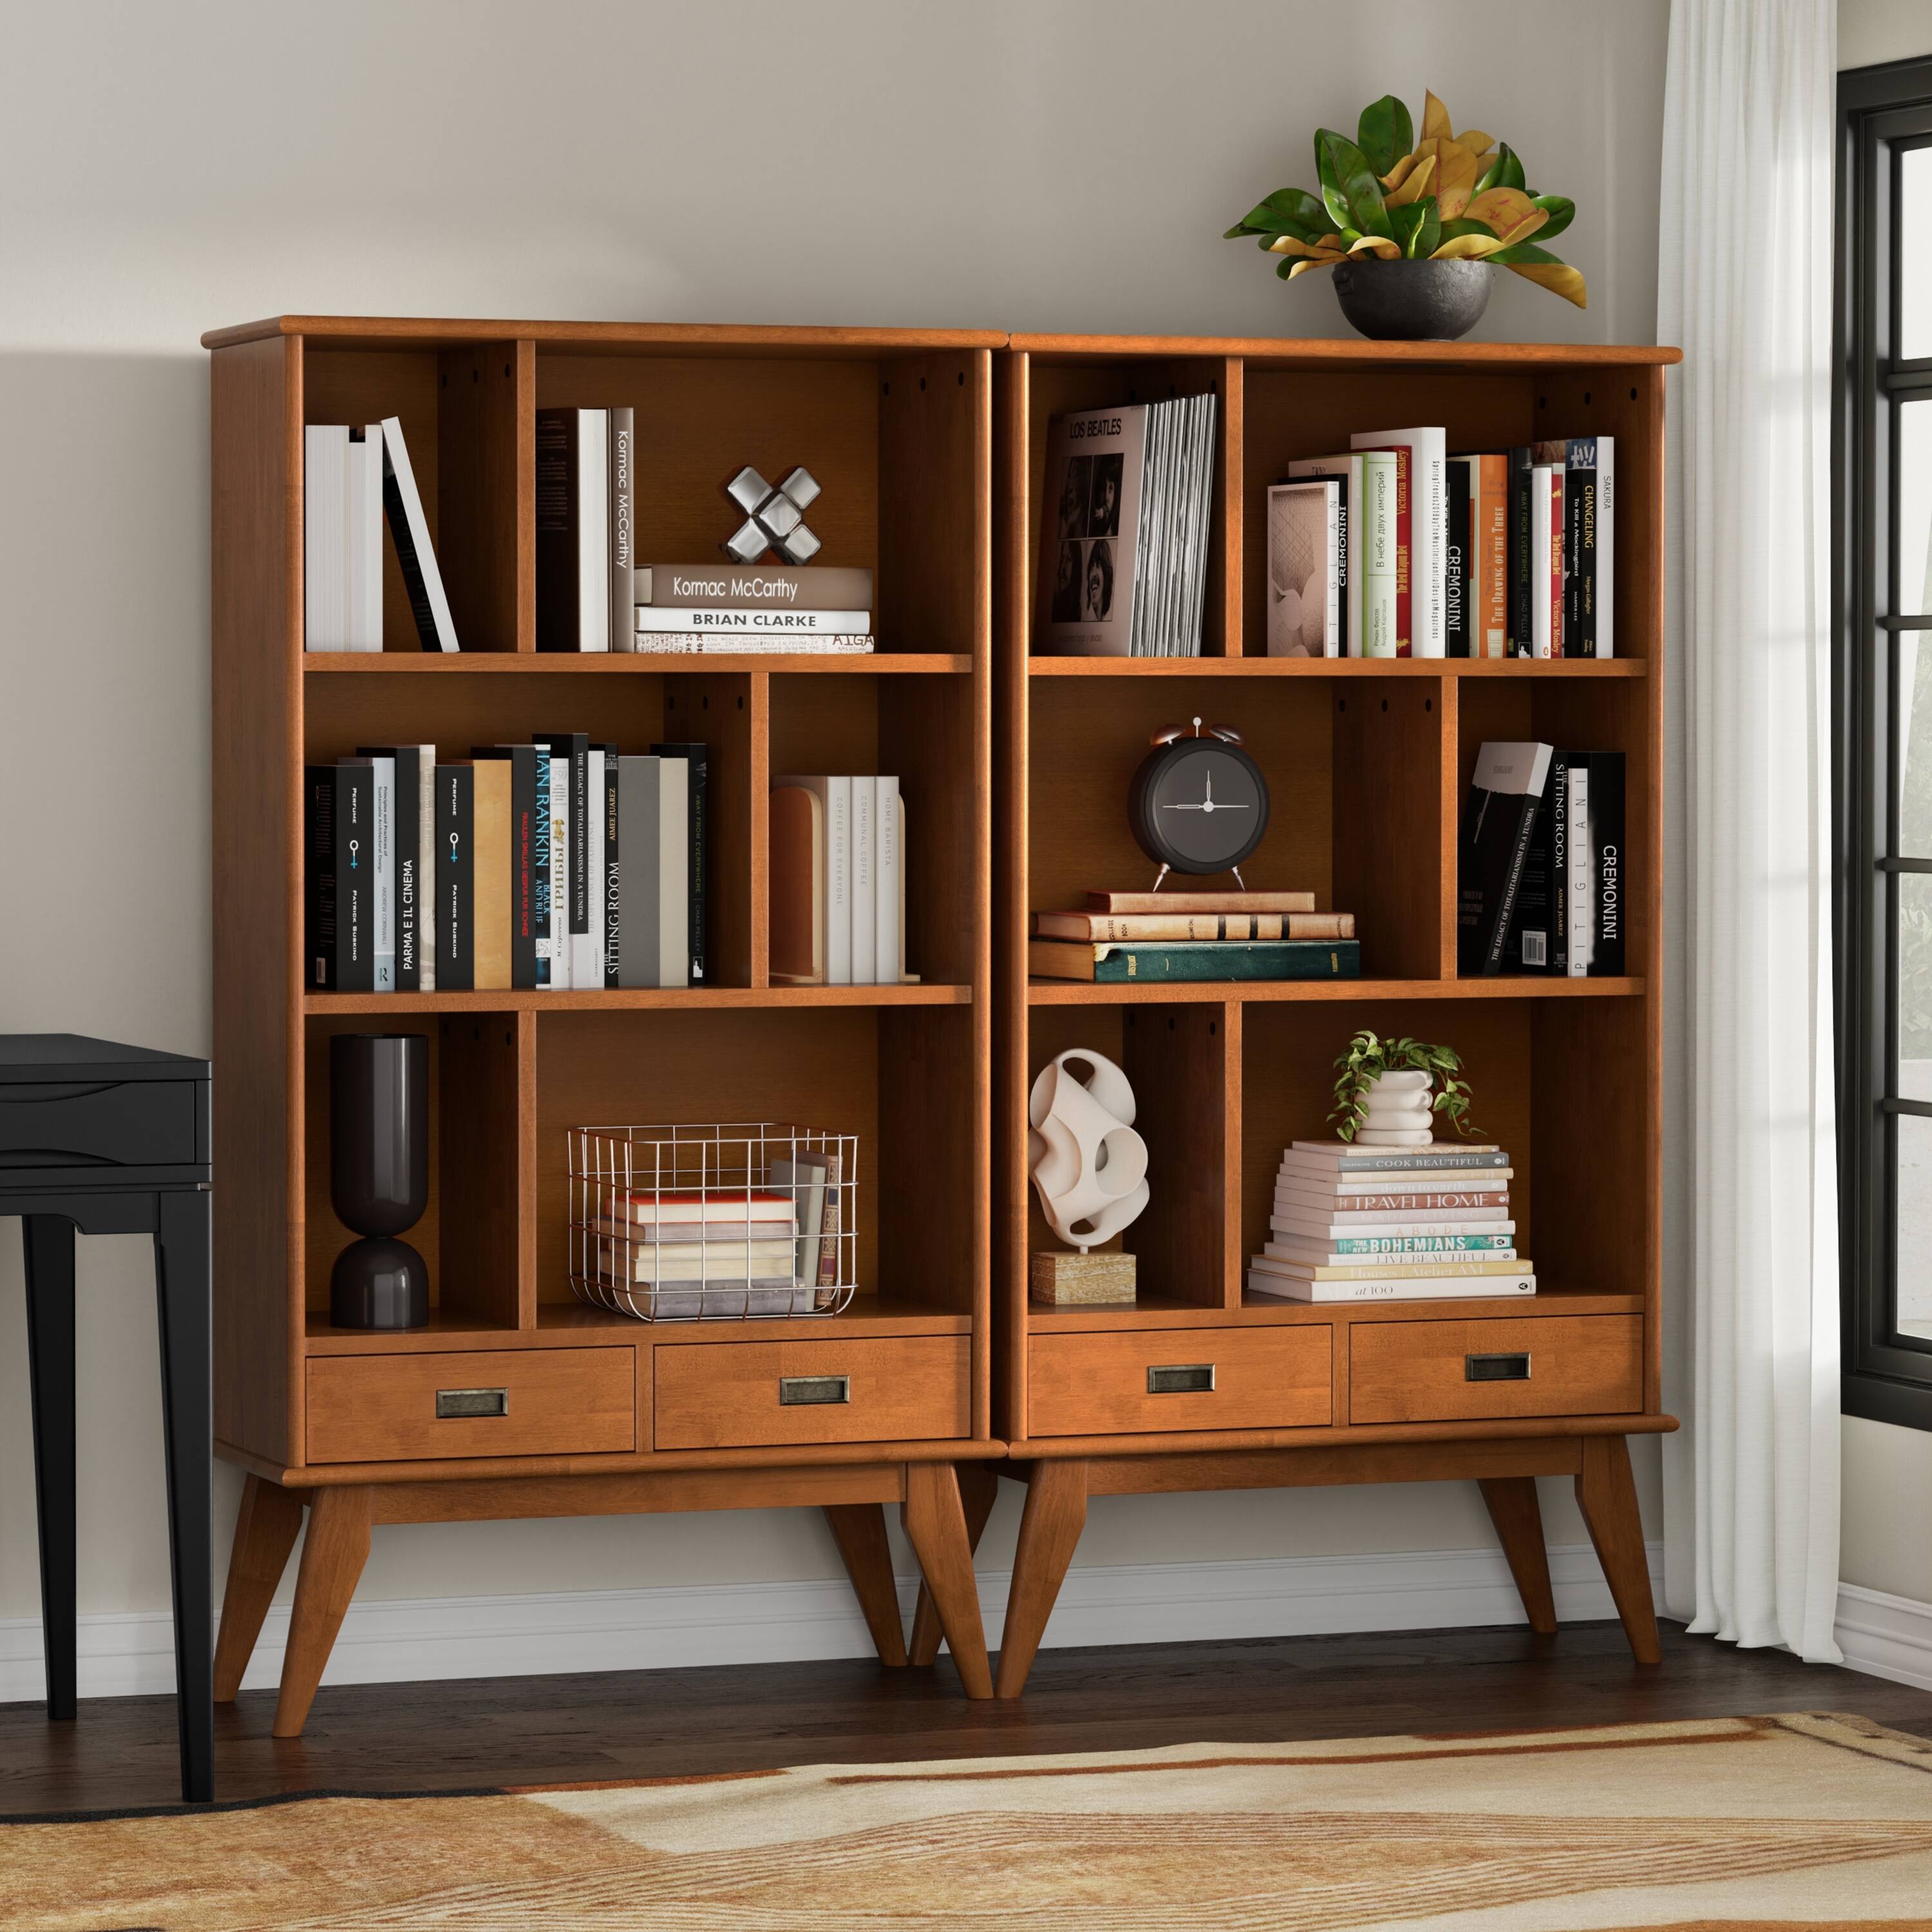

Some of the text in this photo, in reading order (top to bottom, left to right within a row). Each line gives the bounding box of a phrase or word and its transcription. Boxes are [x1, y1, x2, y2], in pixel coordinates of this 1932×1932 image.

[1070, 421, 1084, 439] LOS
[1086, 418, 1122, 437] BEATLES
[1376, 471, 1386, 511] империй
[1397, 450, 1409, 515] Victoria Mosley
[1603, 475, 1611, 509] SAKURA
[616, 430, 628, 569] Kormac McCarthy
[1574, 497, 1579, 507] To
[1584, 485, 1594, 548] CHANGELING
[1376, 537, 1385, 558] небе
[673, 576, 798, 601] Kormac McCarthy
[1448, 545, 1461, 632] CREMONINI
[693, 614, 817, 627] BRIAN CLARKE
[832, 636, 874, 647] AIGA
[1551, 629, 1560, 654] Mosley
[536, 755, 550, 867] IAN RANKIN
[577, 797, 583, 808] OF
[1522, 808, 1535, 835] TUNDRA
[1555, 764, 1564, 868] SITTING ROOM
[1520, 841, 1526, 851] IN
[403, 860, 412, 904] CINEMA
[554, 847, 565, 911] ГРИБЫ
[577, 874, 583, 883] IN
[1504, 851, 1524, 910] TOTALITARIANISM
[1575, 781, 1586, 969] PITIGLIANI
[543, 884, 551, 914] BLACK
[1603, 845, 1616, 940] CREMONINI
[403, 907, 412, 918] IL
[608, 862, 619, 974] SITTING ROOM
[1501, 911, 1509, 920] OF
[1495, 920, 1508, 947] LEGACY
[403, 932, 412, 970] PARMA
[1492, 947, 1500, 961] THE
[1416, 1158, 1482, 1166] BEAUTIFUL
[1381, 1181, 1465, 1193] down to earth
[1354, 1195, 1421, 1210] TRAVEL
[1427, 1193, 1489, 1207] HOME
[1361, 1213, 1406, 1222] MADE
[1424, 1211, 1479, 1220] LIVING
[1396, 1225, 1468, 1237] ABODE
[1370, 1236, 1466, 1253] BOHEMIANS
[1376, 1252, 1490, 1264] LIVE BEAUTIFUL
[1350, 1264, 1484, 1278] Houses Atelier AM
[1355, 1285, 1394, 1296] at 100
